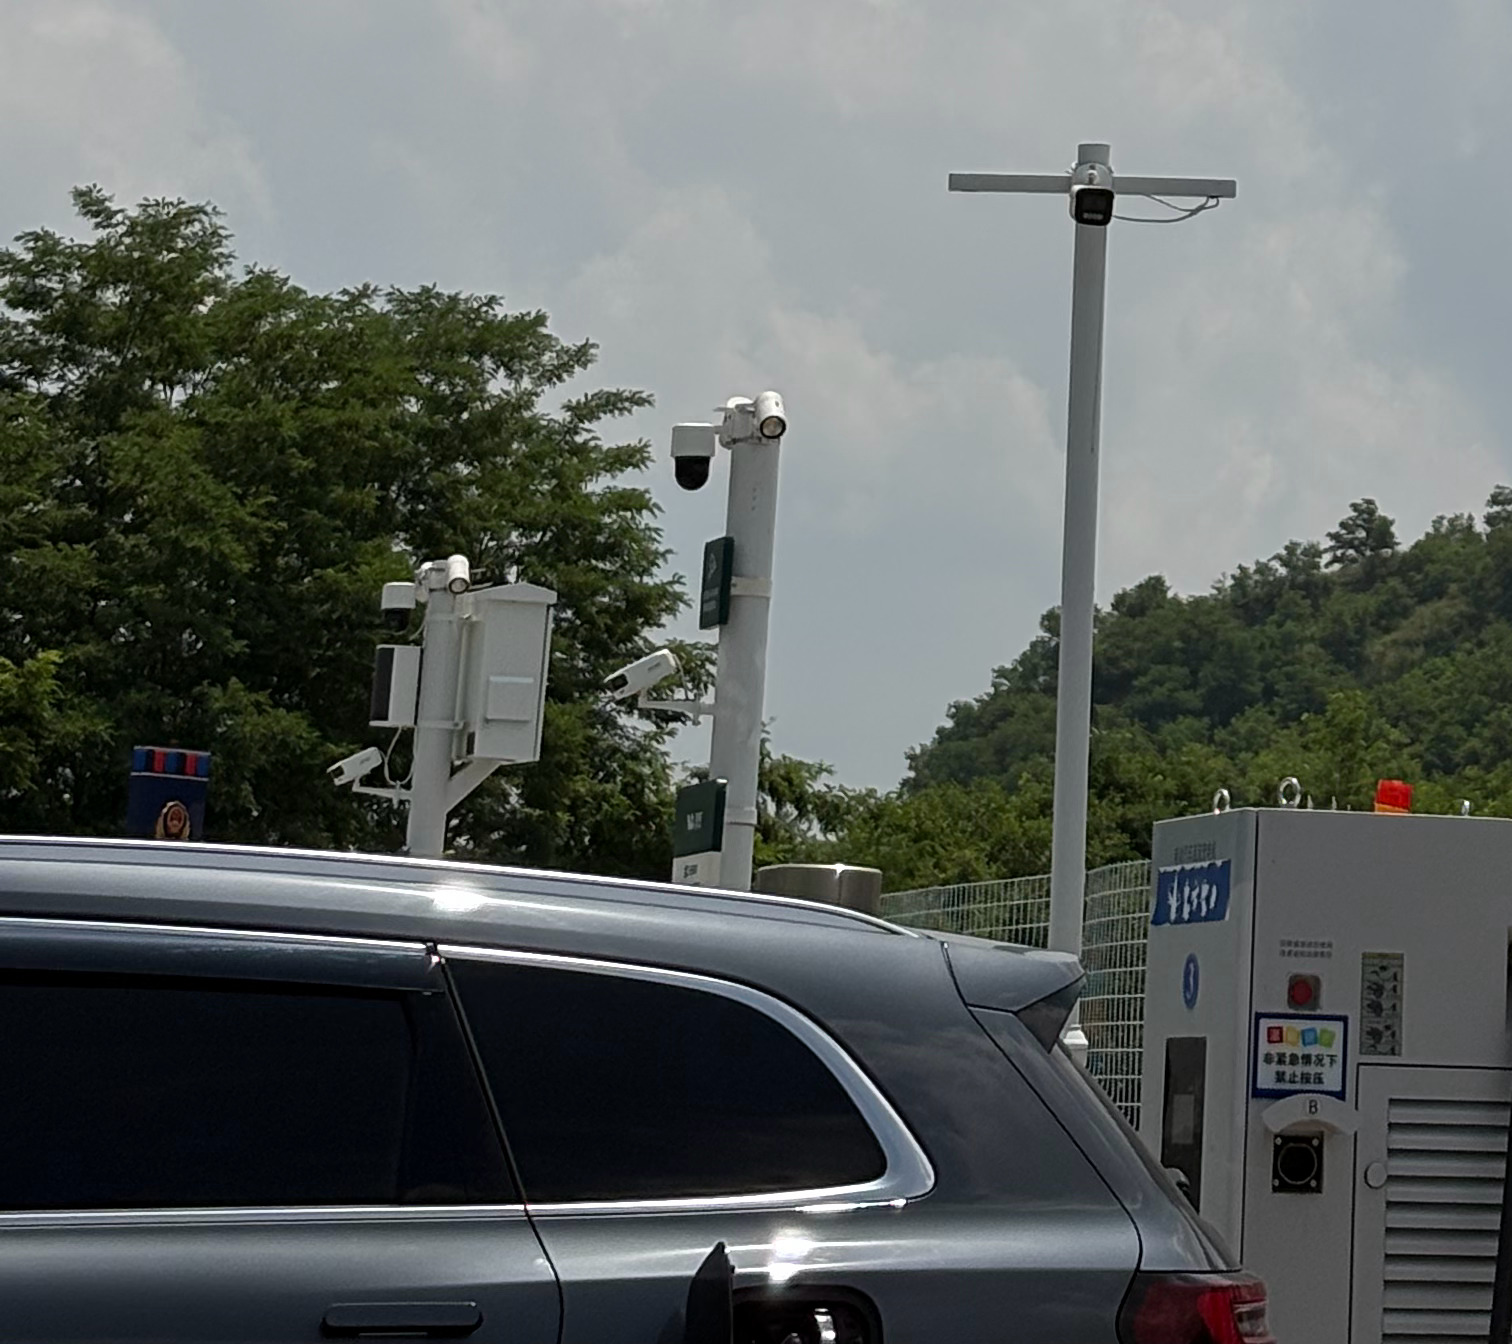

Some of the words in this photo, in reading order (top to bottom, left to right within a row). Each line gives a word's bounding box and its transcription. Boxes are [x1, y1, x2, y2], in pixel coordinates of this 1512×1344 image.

[1263, 1052, 1338, 1068] 非紧急情况下
[1275, 1069, 1325, 1085] 禁止按压
[1309, 1099, 1318, 1114] B
